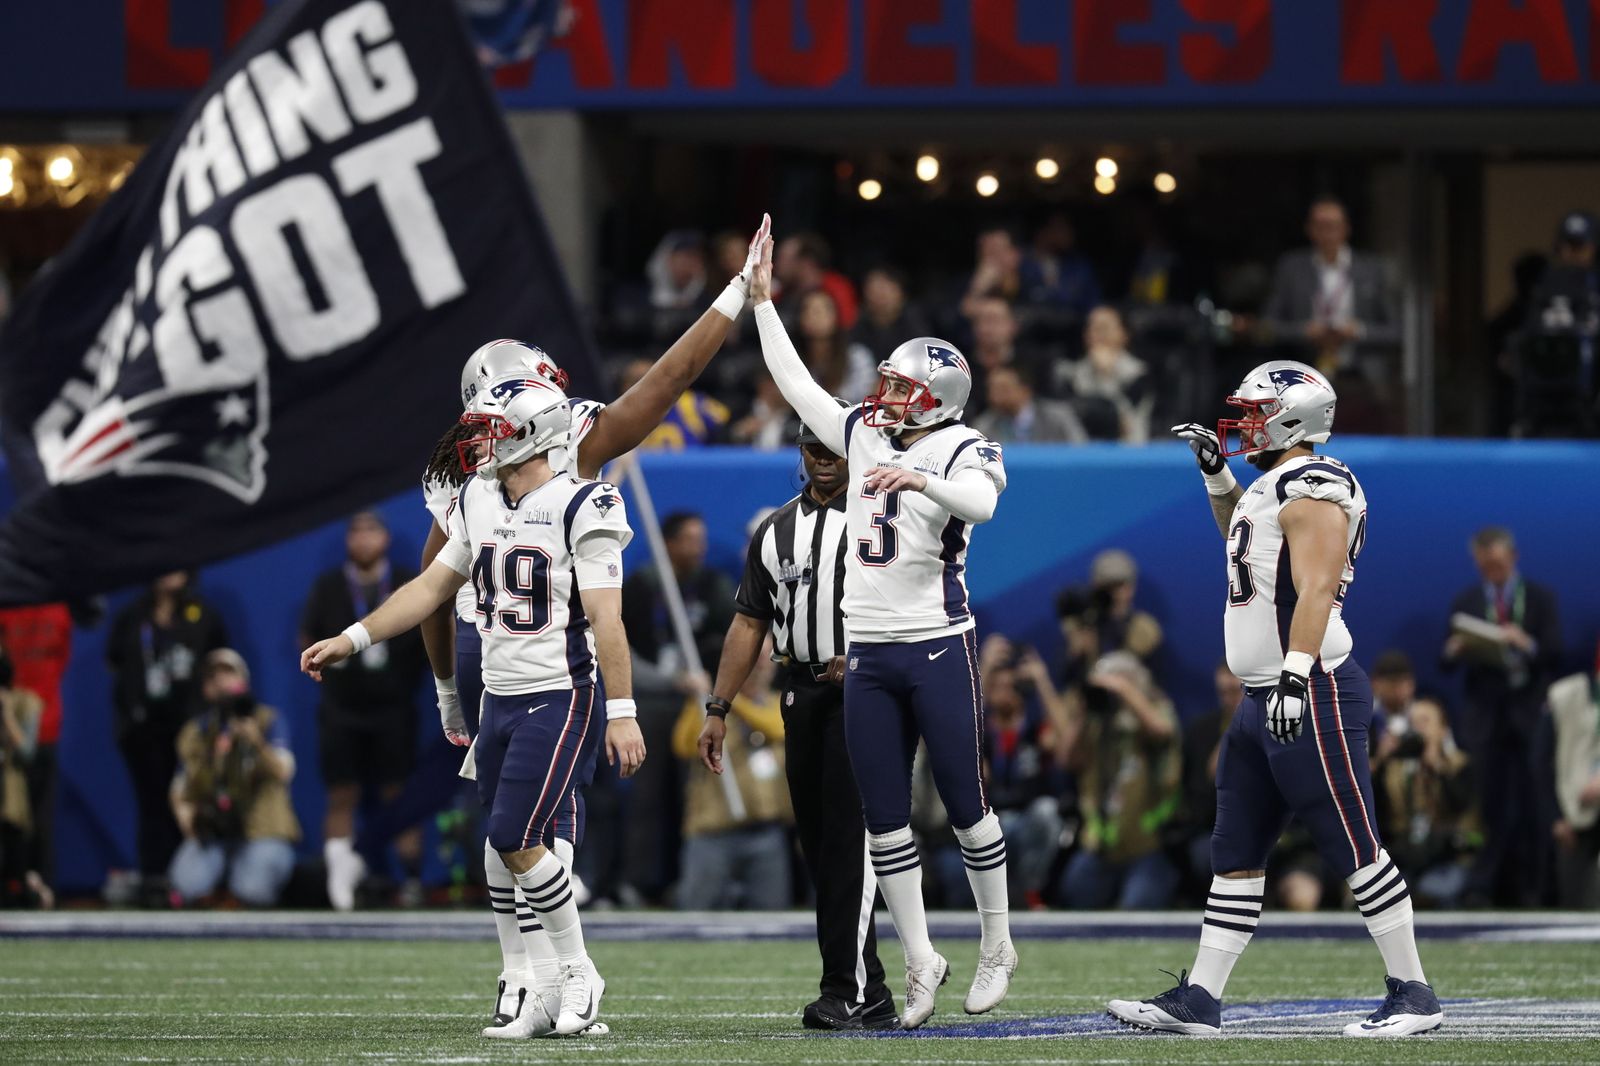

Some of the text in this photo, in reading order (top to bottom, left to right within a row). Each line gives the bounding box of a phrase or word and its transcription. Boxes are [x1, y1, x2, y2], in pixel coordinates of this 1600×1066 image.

[1339, 0, 1600, 86] RA
[152, 115, 467, 392] GOT
[464, 383, 478, 402] 68
[856, 481, 902, 568] 3
[469, 542, 553, 635] 49
